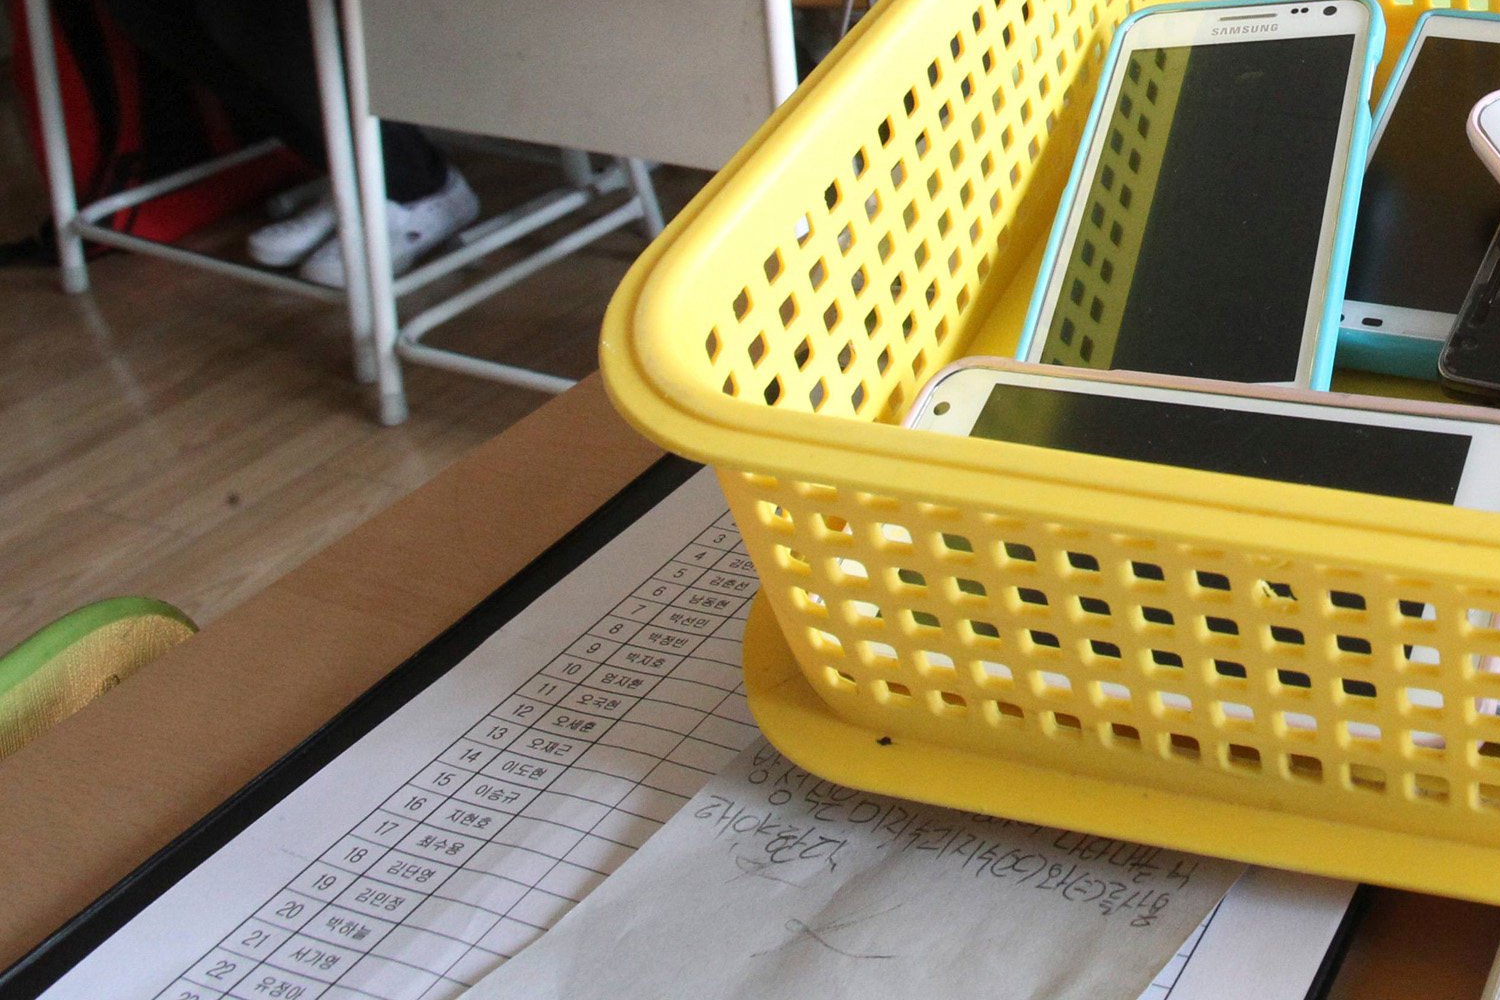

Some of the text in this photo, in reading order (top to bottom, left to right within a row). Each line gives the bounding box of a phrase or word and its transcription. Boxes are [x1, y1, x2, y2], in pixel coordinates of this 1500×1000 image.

[1212, 24, 1279, 36] SAMSUNG
[713, 534, 726, 544] 3
[694, 551, 707, 560] 4
[673, 568, 688, 578] 5
[652, 586, 667, 597] 6
[631, 604, 646, 615] 7
[609, 623, 689, 649] 8 박정빈
[586, 643, 666, 669] 9 박지호
[561, 662, 644, 690] 10 엄지환
[537, 682, 621, 711] 11 오국현
[511, 703, 597, 733] 12 오세훈
[486, 726, 573, 757] 13 오재근
[459, 748, 548, 781] 14 이도현
[432, 771, 521, 804] 15 이승규
[403, 795, 493, 829] 16 지현호
[374, 820, 465, 856] 17 최수용
[343, 846, 437, 883] 18 김단영
[311, 873, 406, 912] 19 김민정
[275, 901, 372, 940] 20 박하늘
[241, 930, 342, 970] 21 서가영
[206, 960, 237, 980] 22
